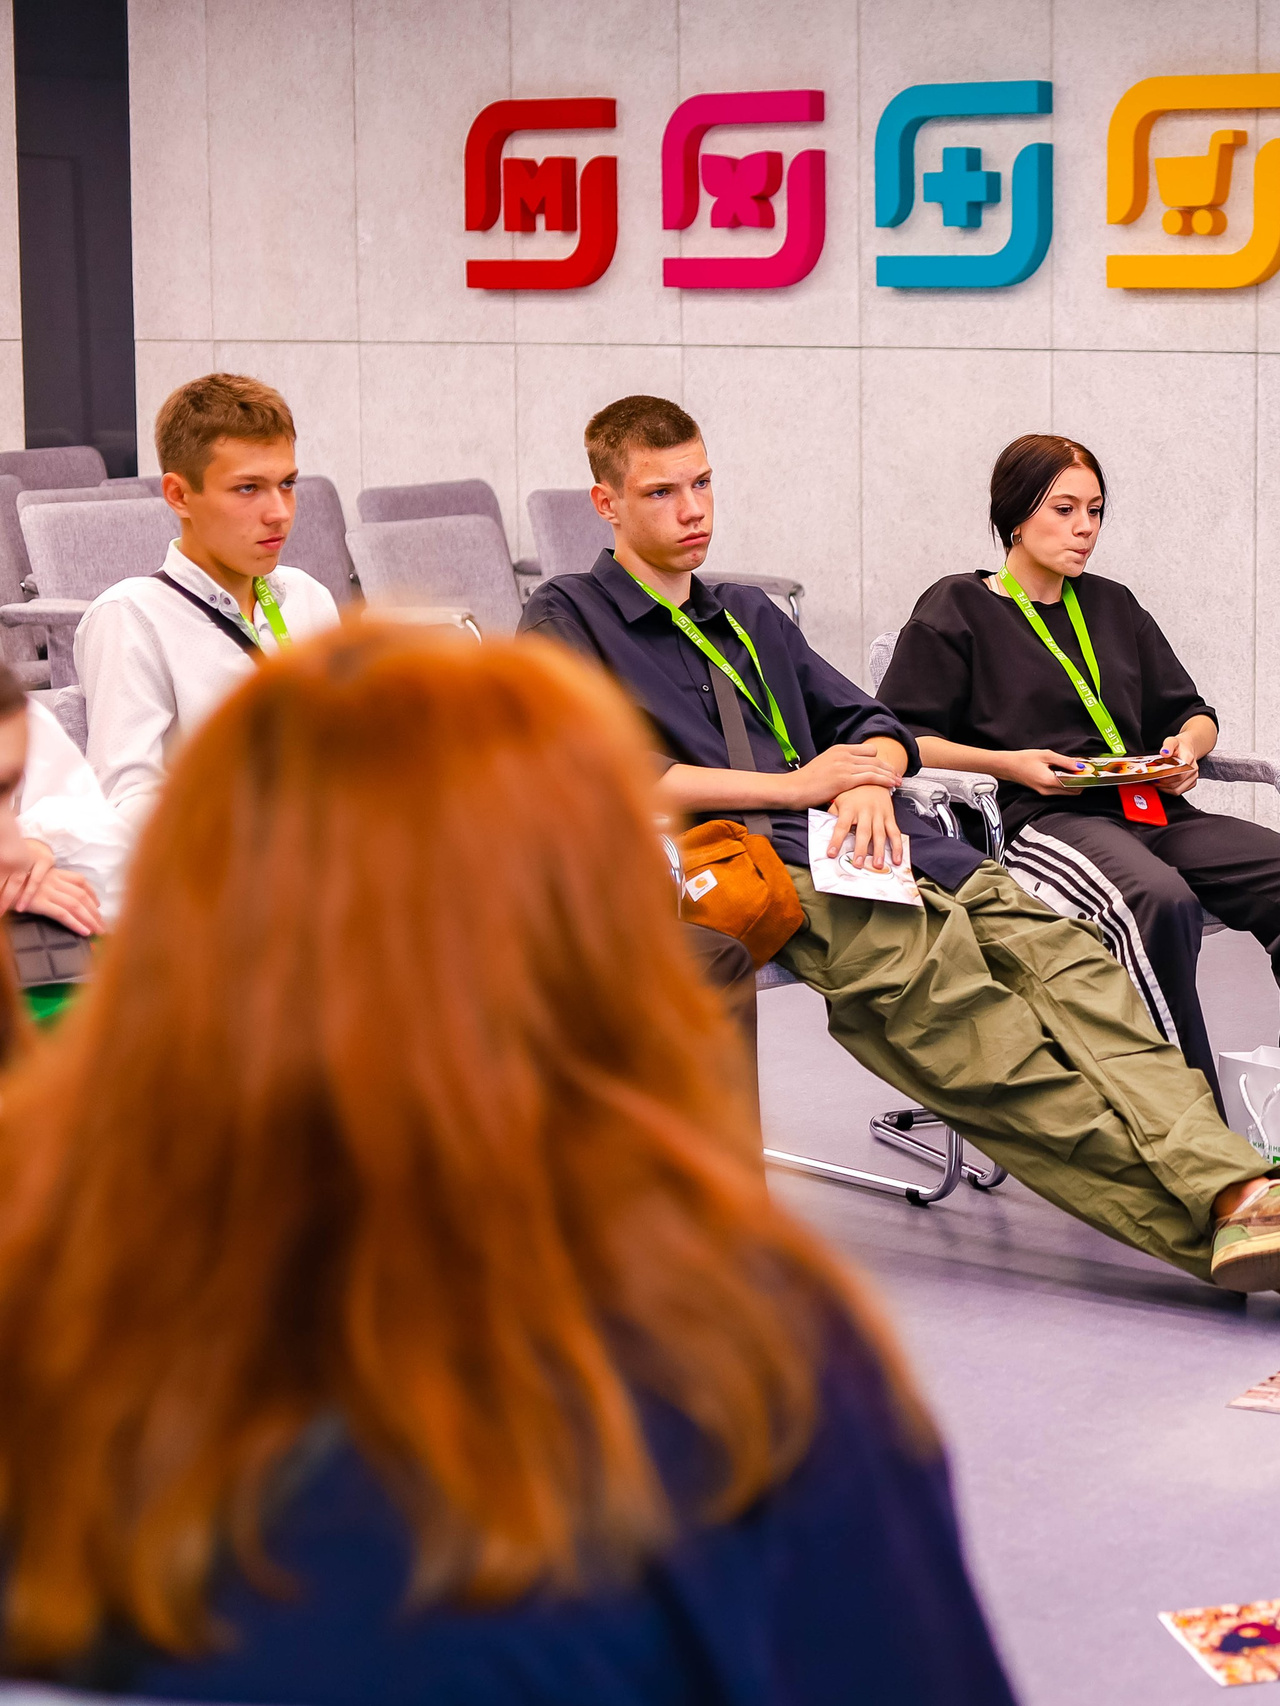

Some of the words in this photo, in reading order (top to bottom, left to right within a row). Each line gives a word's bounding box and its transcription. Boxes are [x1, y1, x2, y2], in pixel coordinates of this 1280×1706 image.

[1017, 591, 1032, 611] LIFE
[685, 627, 704, 646] LIFE
[1077, 679, 1091, 697] LIFE
[1105, 726, 1120, 745] LIFE
